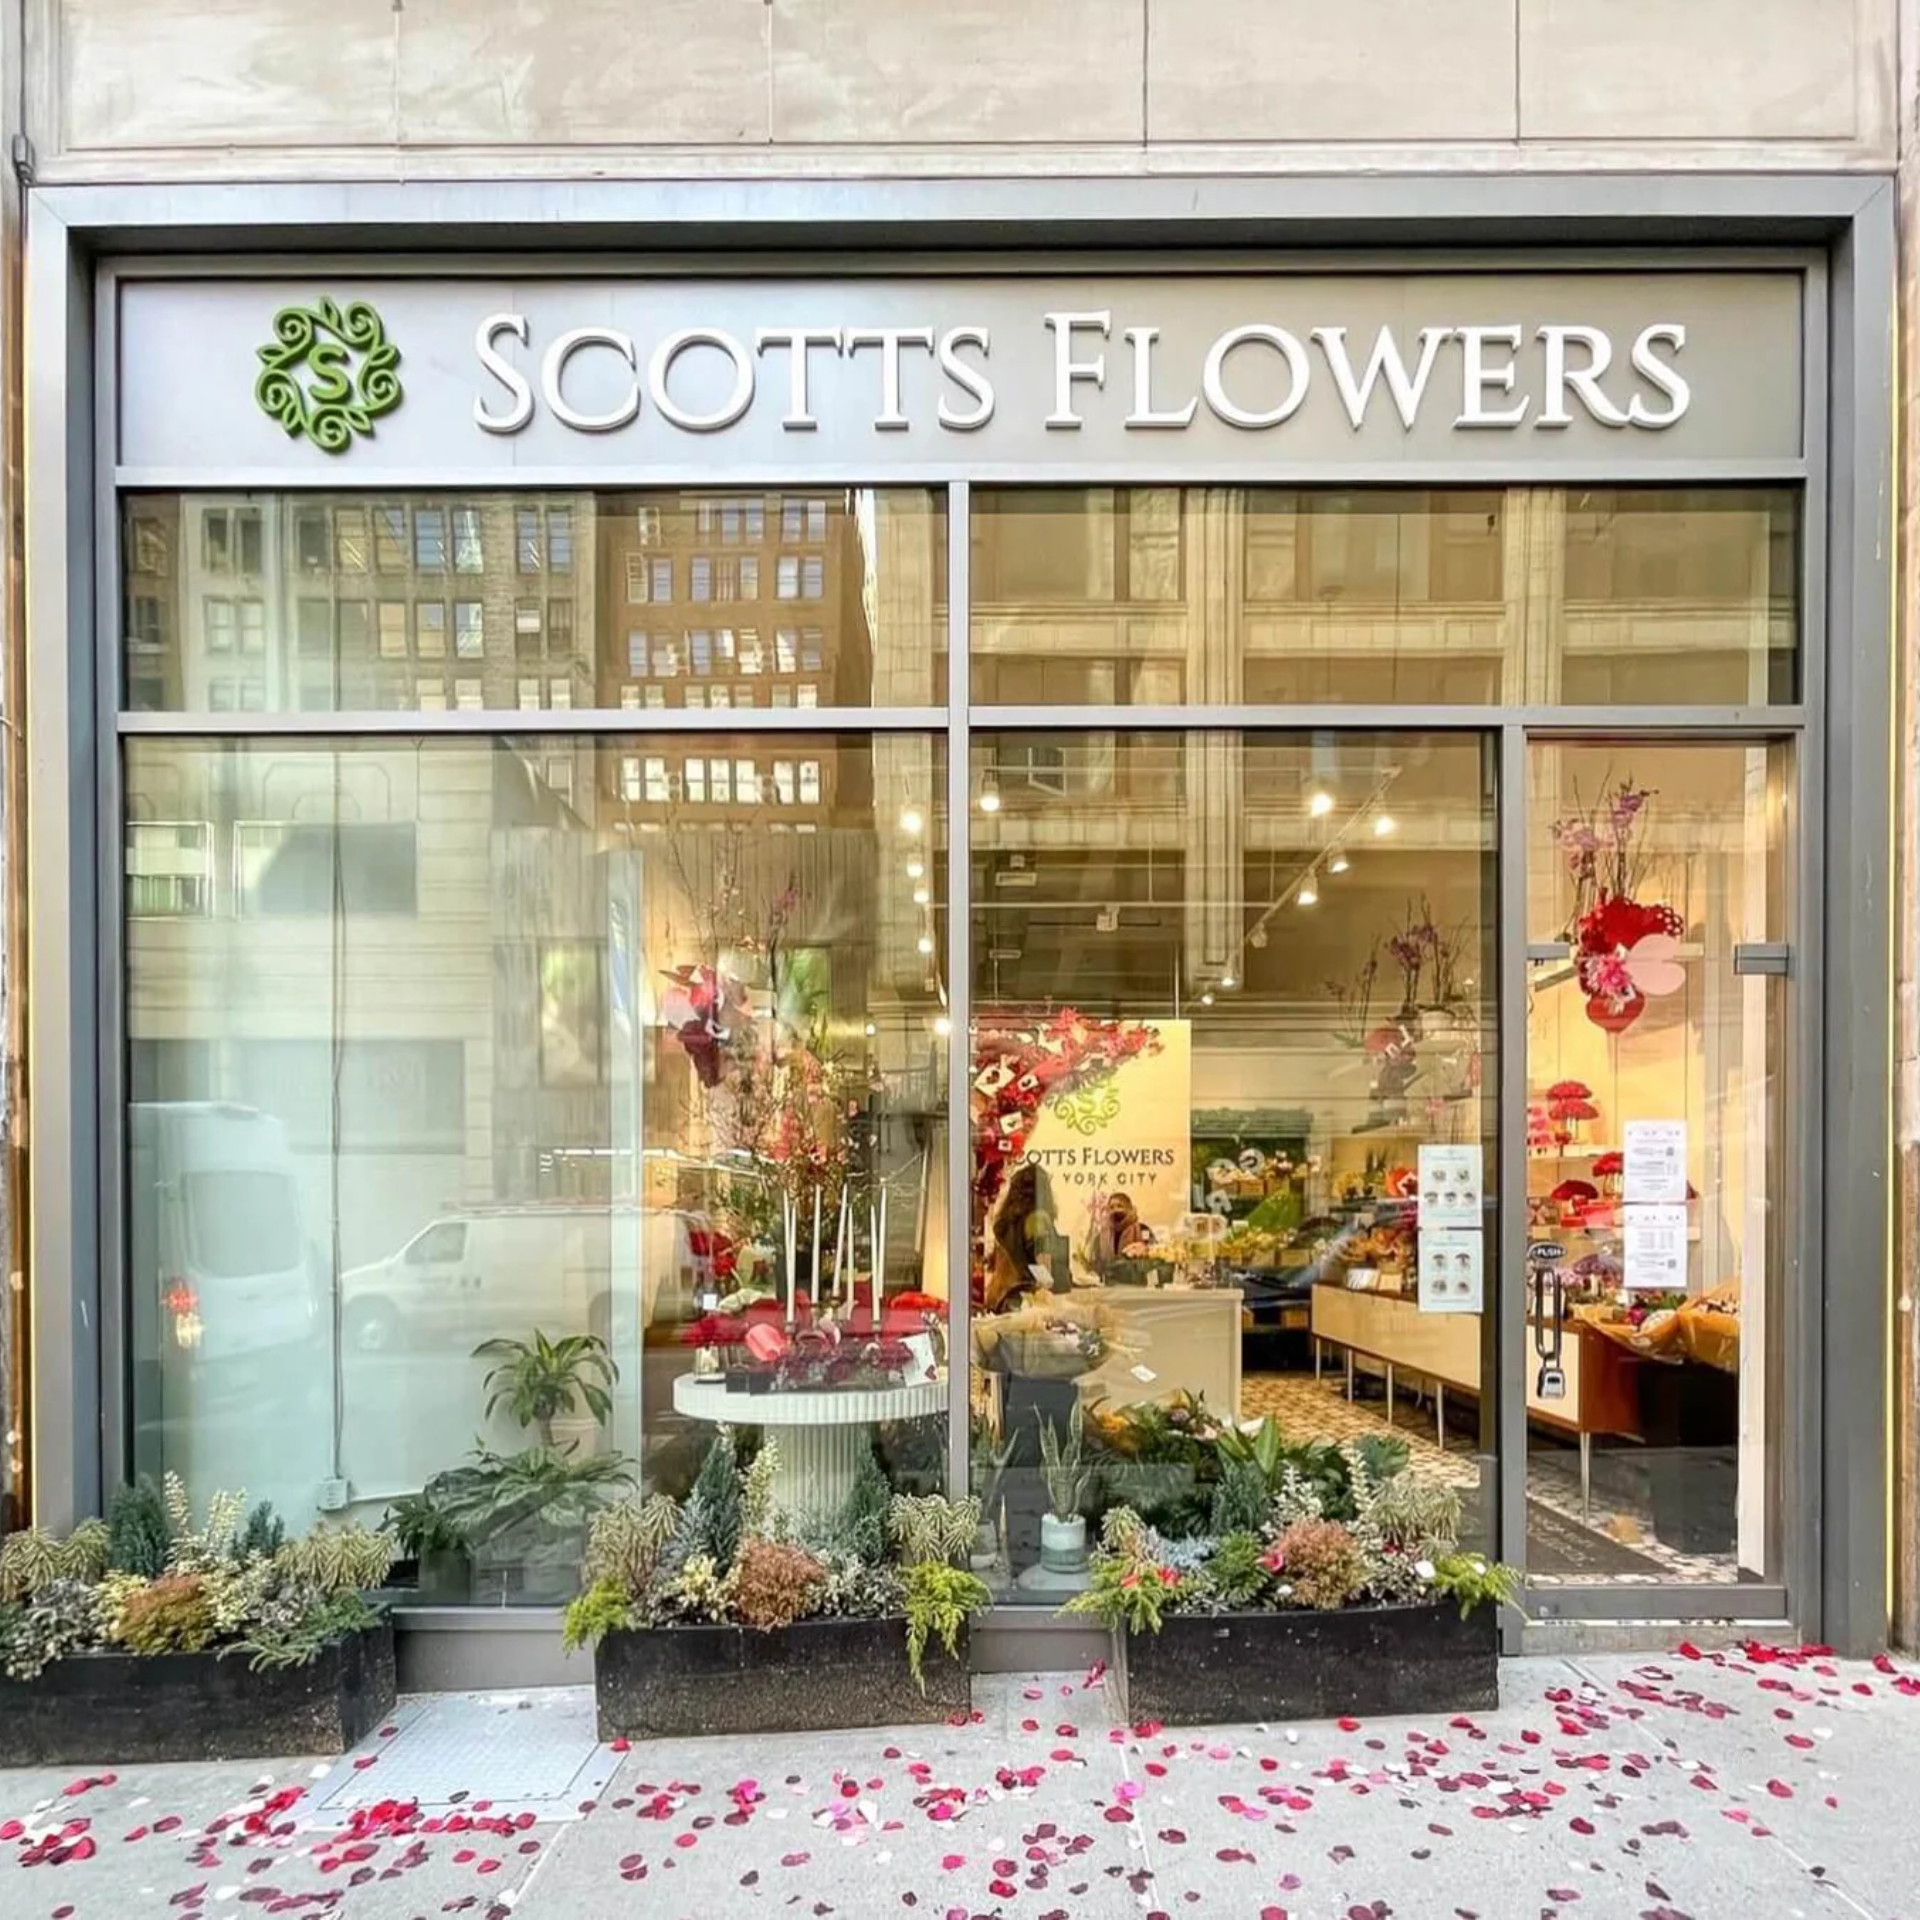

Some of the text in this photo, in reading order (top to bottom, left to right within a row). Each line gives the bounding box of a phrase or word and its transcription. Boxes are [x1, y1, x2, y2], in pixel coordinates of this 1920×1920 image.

[307, 343, 353, 405] S
[473, 310, 1692, 435] SCOTTS FLOWERS
[1008, 1147, 1174, 1166] COTTS FLOWERS
[1063, 1172, 1108, 1186] YORK
[1116, 1172, 1157, 1186] CITY
